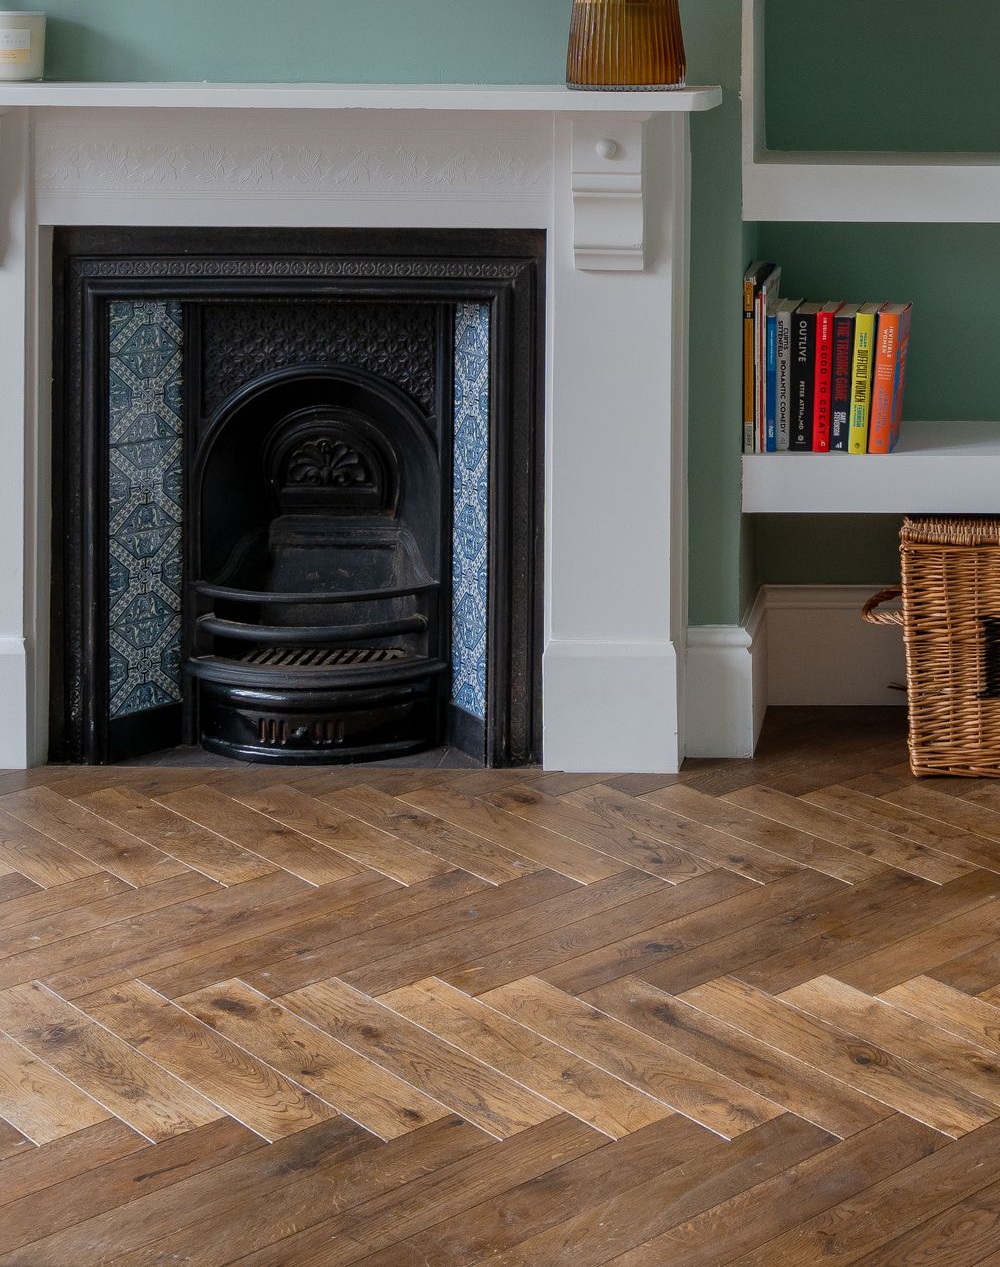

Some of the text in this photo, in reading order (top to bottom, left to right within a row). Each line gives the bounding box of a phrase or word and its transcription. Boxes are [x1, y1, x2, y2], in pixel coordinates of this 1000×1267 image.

[798, 320, 807, 363] OUTLIVE
[820, 344, 828, 375] GOOD
[881, 328, 889, 354] WOMEN
[834, 321, 849, 402] THE TRADING GAME
[854, 349, 869, 403] DIFFICULT WOMEN
[820, 381, 827, 394] TO
[819, 399, 827, 436] GREAT
